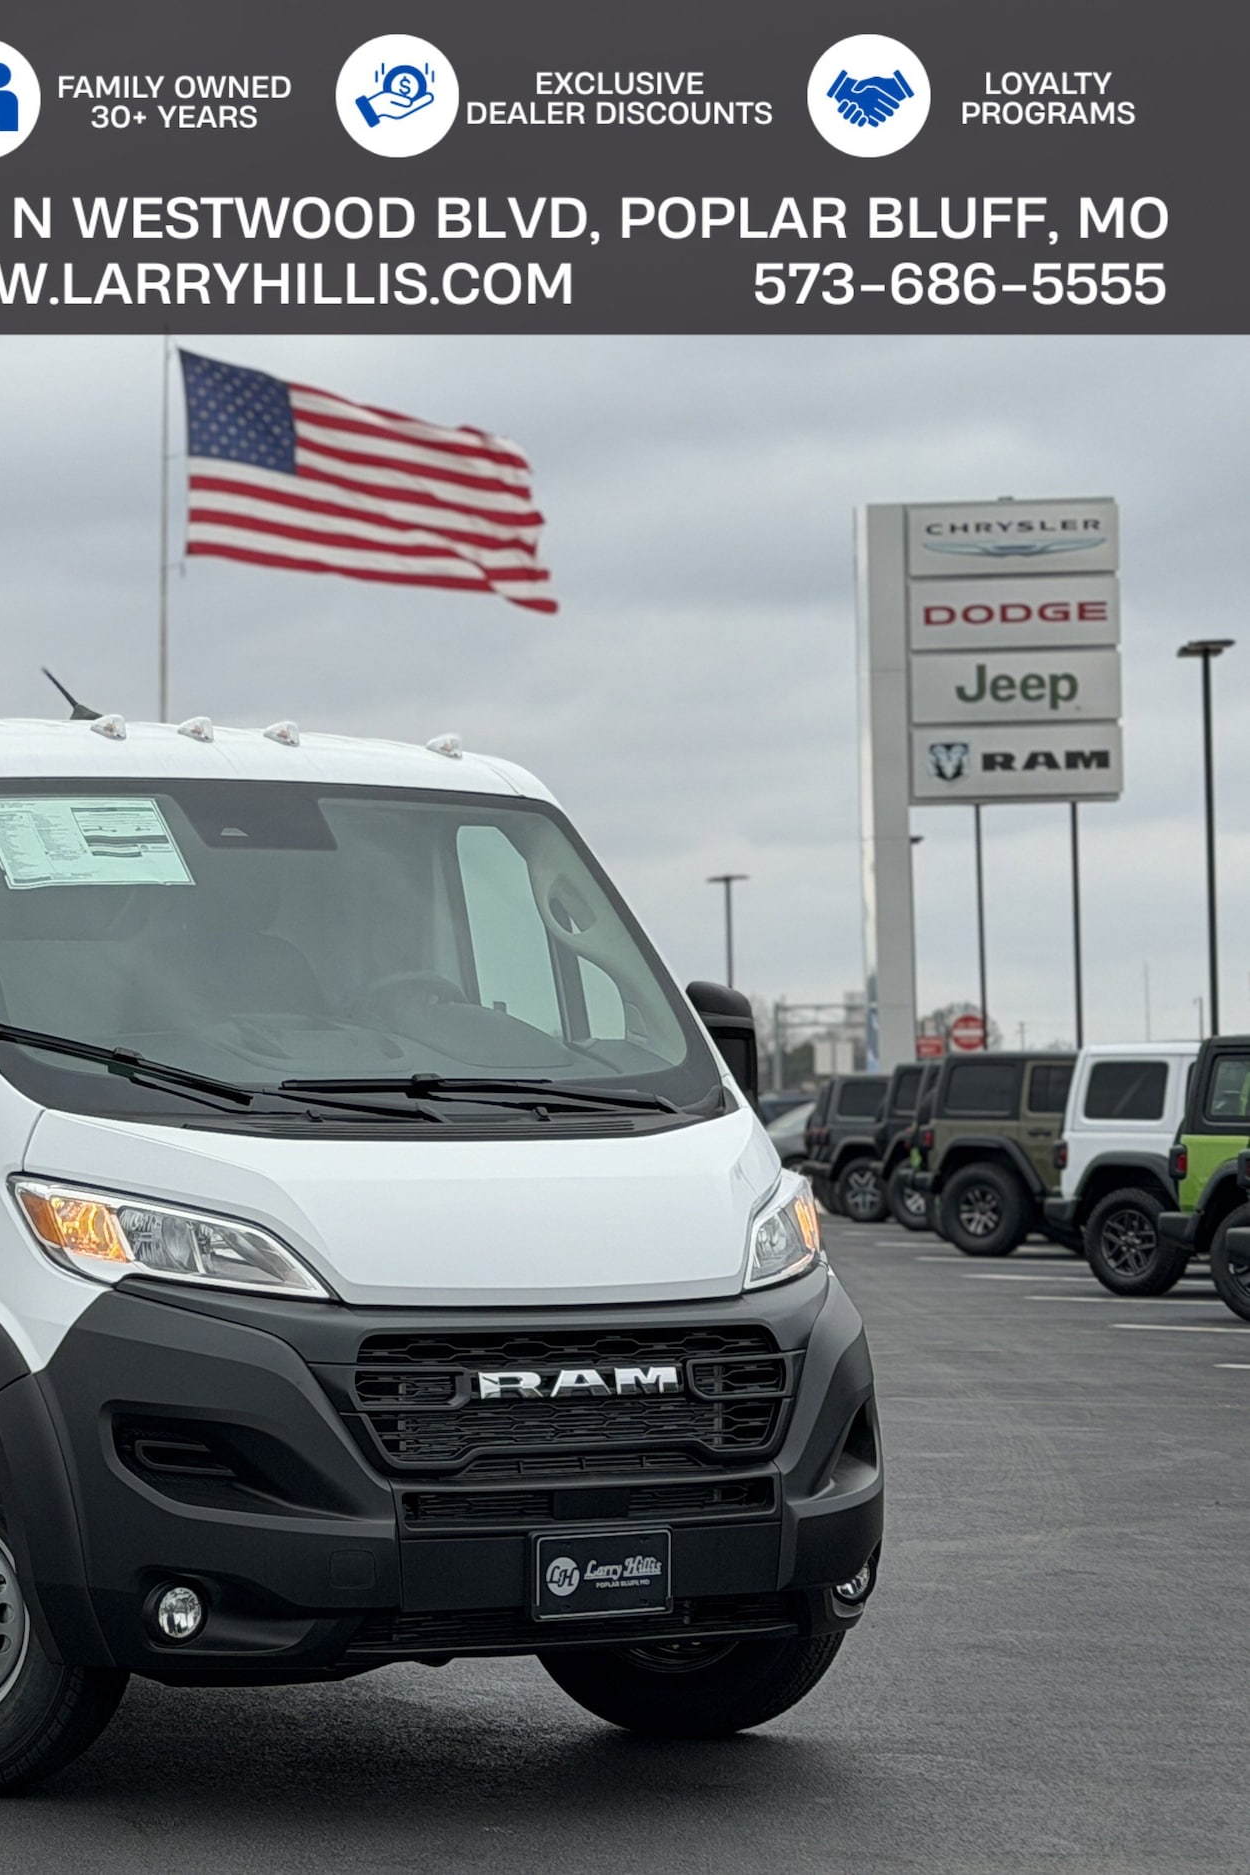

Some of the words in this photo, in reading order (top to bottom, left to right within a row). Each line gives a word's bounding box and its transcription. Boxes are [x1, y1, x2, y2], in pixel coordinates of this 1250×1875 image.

[924, 518, 1103, 535] CHRYSLER
[923, 600, 1109, 626] DODGE
[955, 664, 1079, 710] Jeep
[981, 749, 1111, 772] RAM
[478, 1366, 681, 1399] RAM
[583, 1559, 622, 1580] Larry
[623, 1555, 662, 1577] Hillis
